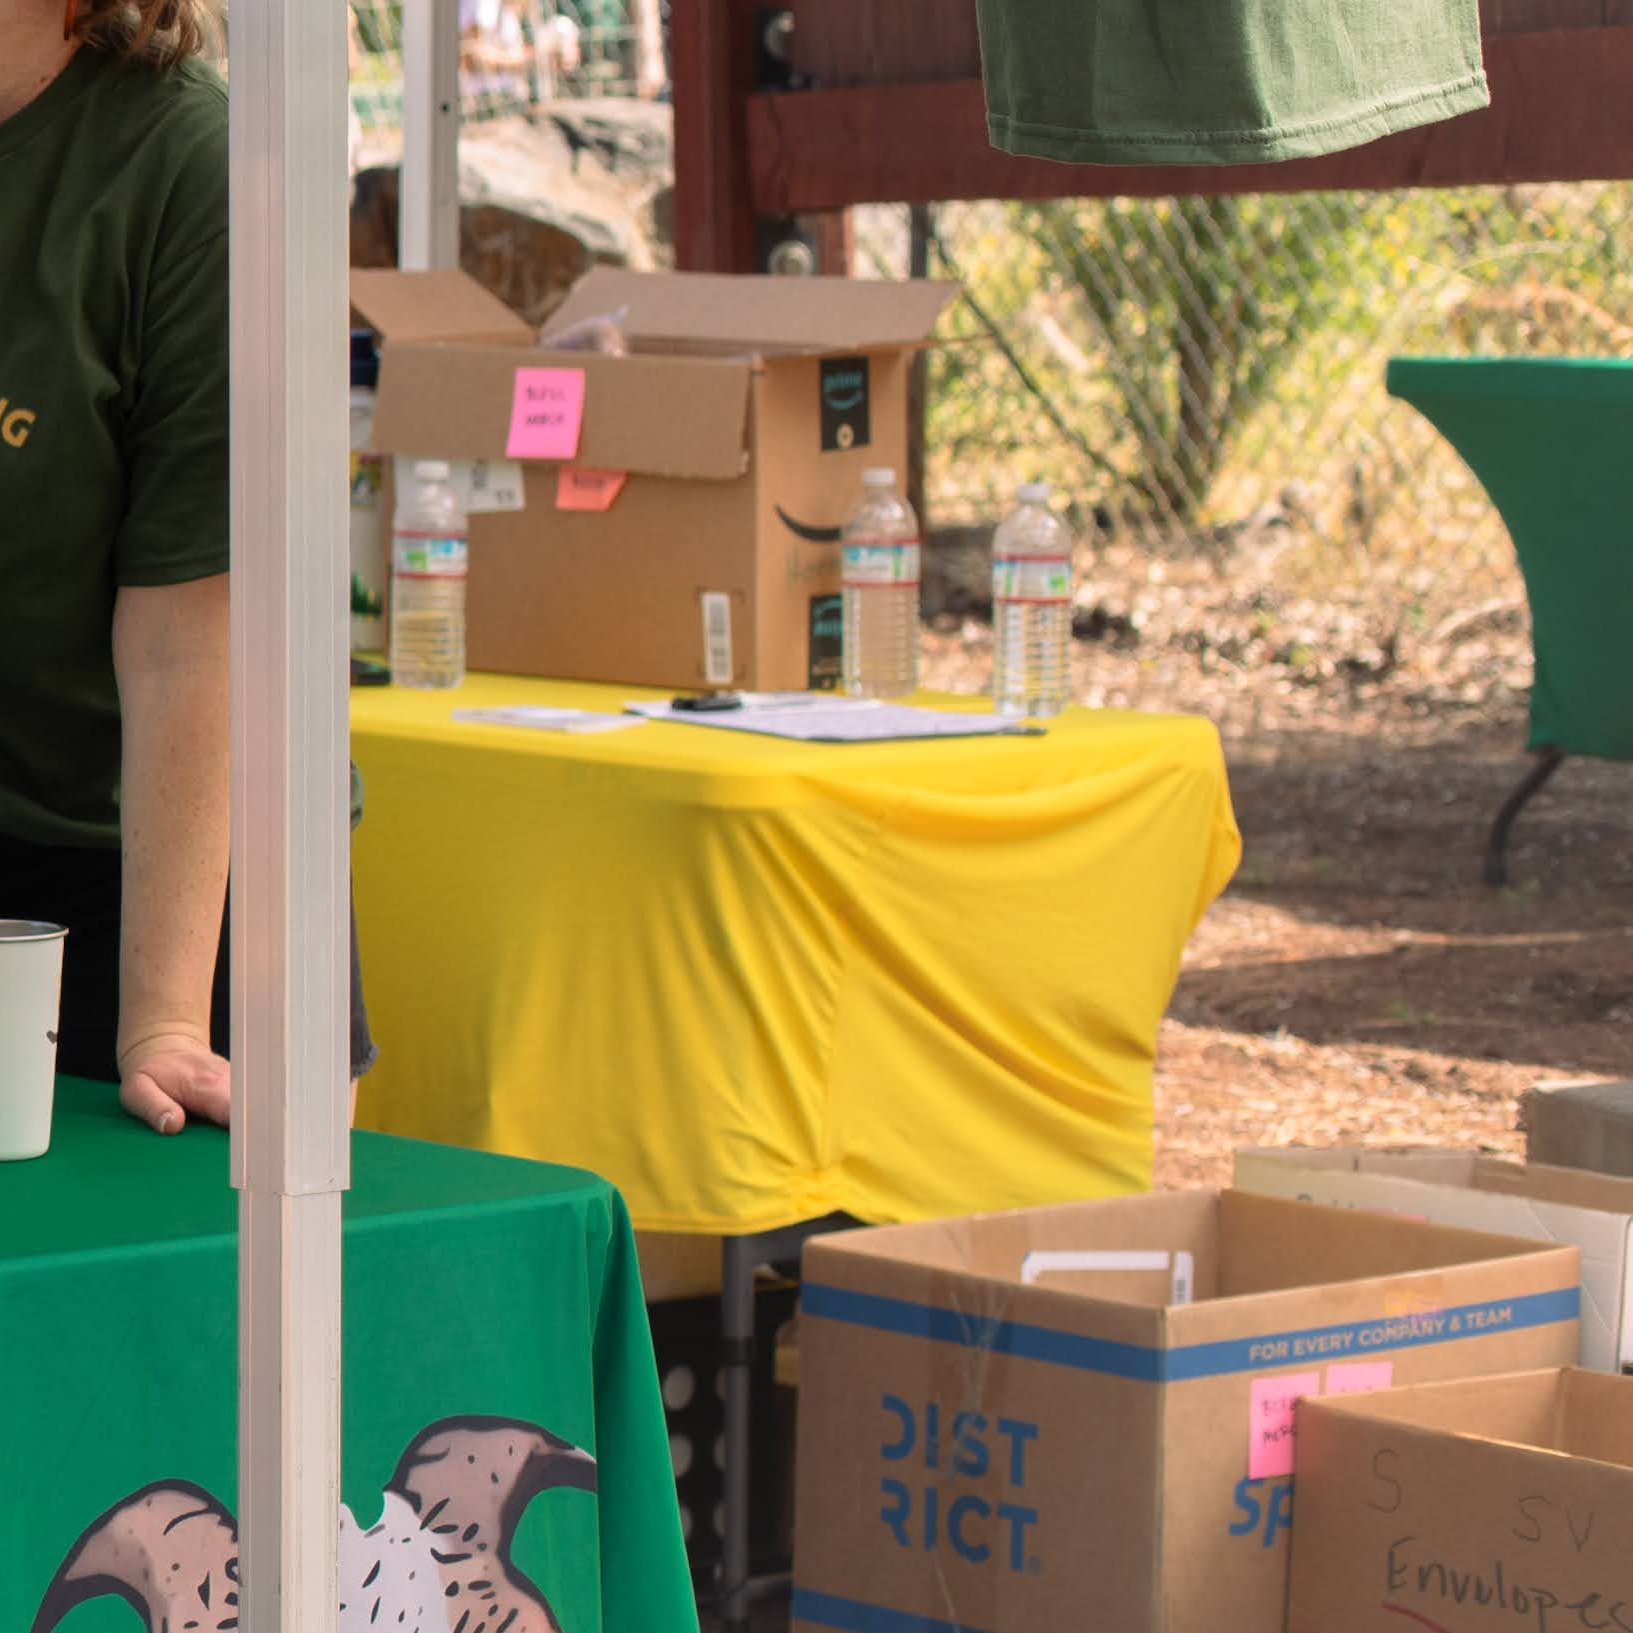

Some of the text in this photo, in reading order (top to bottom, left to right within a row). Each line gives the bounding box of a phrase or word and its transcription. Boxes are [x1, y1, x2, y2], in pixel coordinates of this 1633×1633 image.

[1248, 1306, 1513, 1362] FOR EVERY COMPANY & TEAM
[880, 1392, 1039, 1487] DIST
